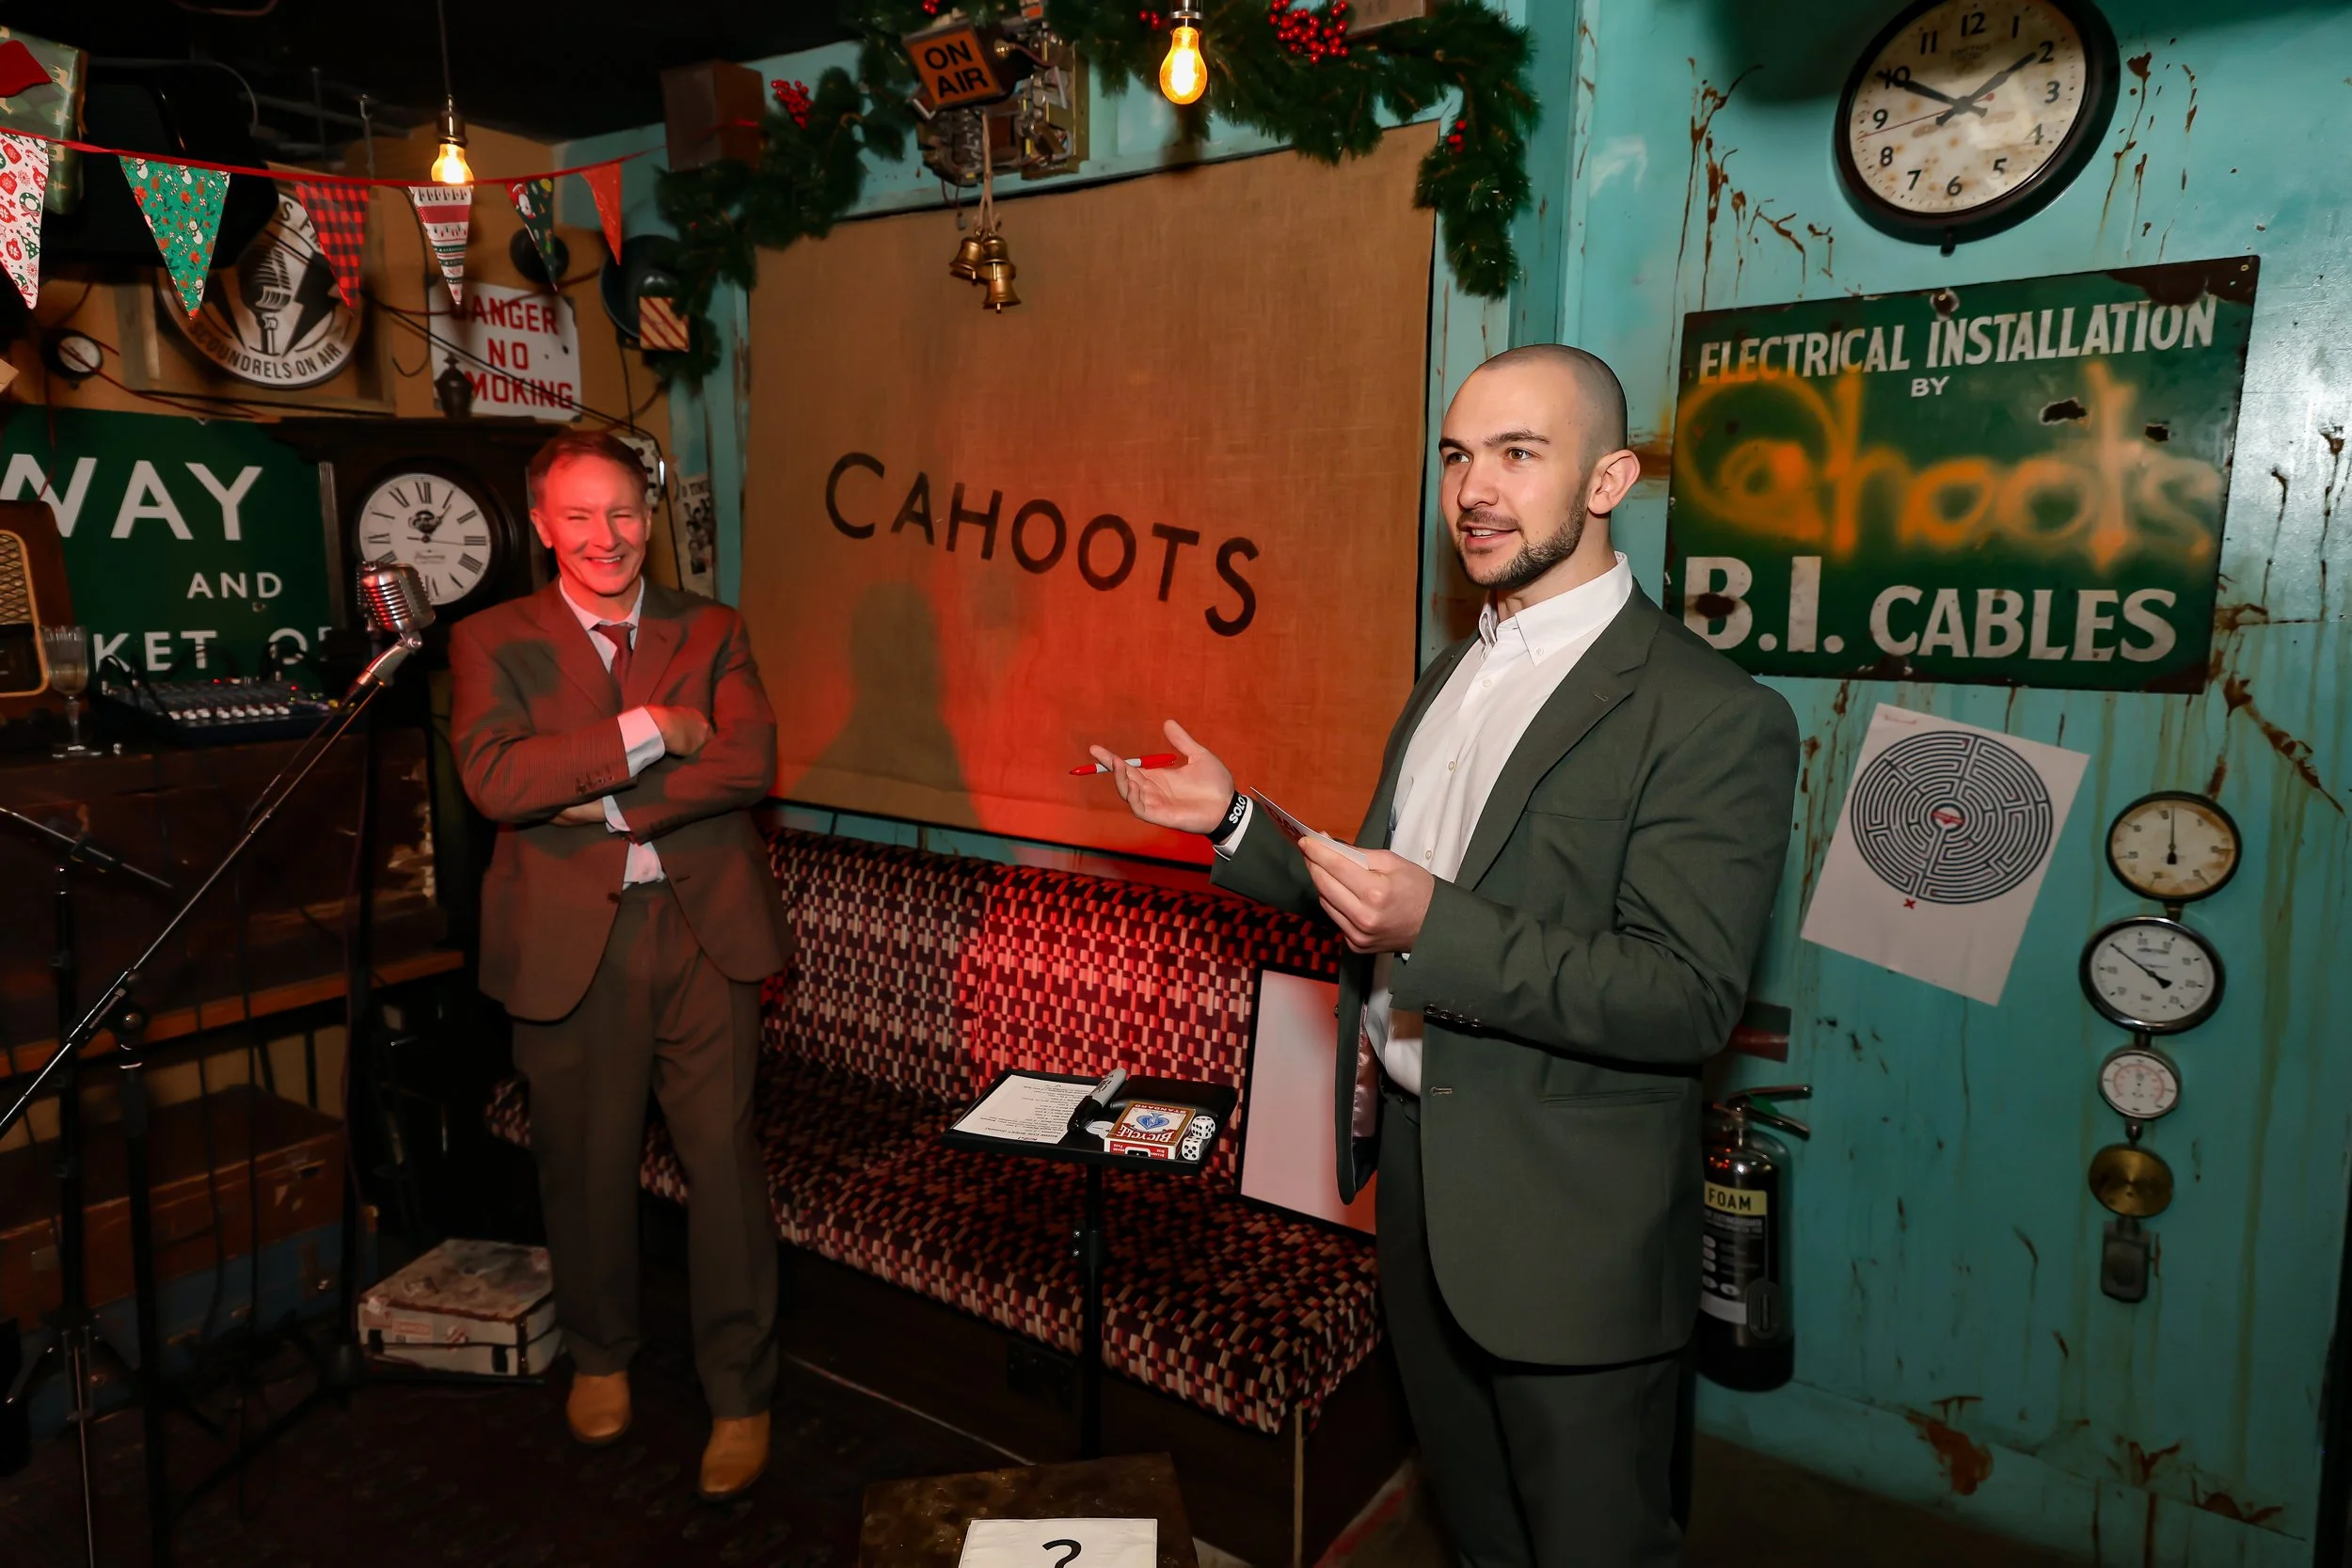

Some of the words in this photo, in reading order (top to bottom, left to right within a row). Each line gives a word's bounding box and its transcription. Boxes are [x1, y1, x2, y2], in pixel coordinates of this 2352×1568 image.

[1960, 11, 1986, 38] 12
[2011, 15, 2020, 39] 1
[1919, 30, 1938, 55] 11
[2037, 40, 2055, 64] 2
[923, 40, 974, 71] ON
[937, 68, 989, 99] AIR
[2044, 81, 2060, 103] 3
[1872, 109, 1888, 129] 9
[2024, 123, 2044, 146] 4
[1880, 146, 1894, 167] 8
[1993, 158, 2007, 179] 5
[1907, 169, 1922, 191] 7
[1947, 176, 1963, 197] 6
[188, 321, 292, 379] SCOUNDRELS
[295, 360, 318, 376] ON
[317, 342, 342, 367] AIR
[1699, 325, 1911, 385] ELECTRICAL
[1927, 296, 2217, 369] INSTALLATION
[487, 338, 529, 371] NO
[465, 371, 574, 410] MOKING
[1910, 376, 1950, 398] BY
[825, 451, 1260, 637] CAHOOTS
[186, 571, 283, 599] AND
[1683, 556, 1846, 654] B.I.
[1869, 584, 2178, 661] CABLES
[93, 630, 217, 673] KET
[1229, 796, 1247, 824] SOLO
[1135, 1103, 1187, 1114] STANDARD
[1116, 1123, 1175, 1142] BICYCLE
[1708, 1187, 1752, 1212] FOAM
